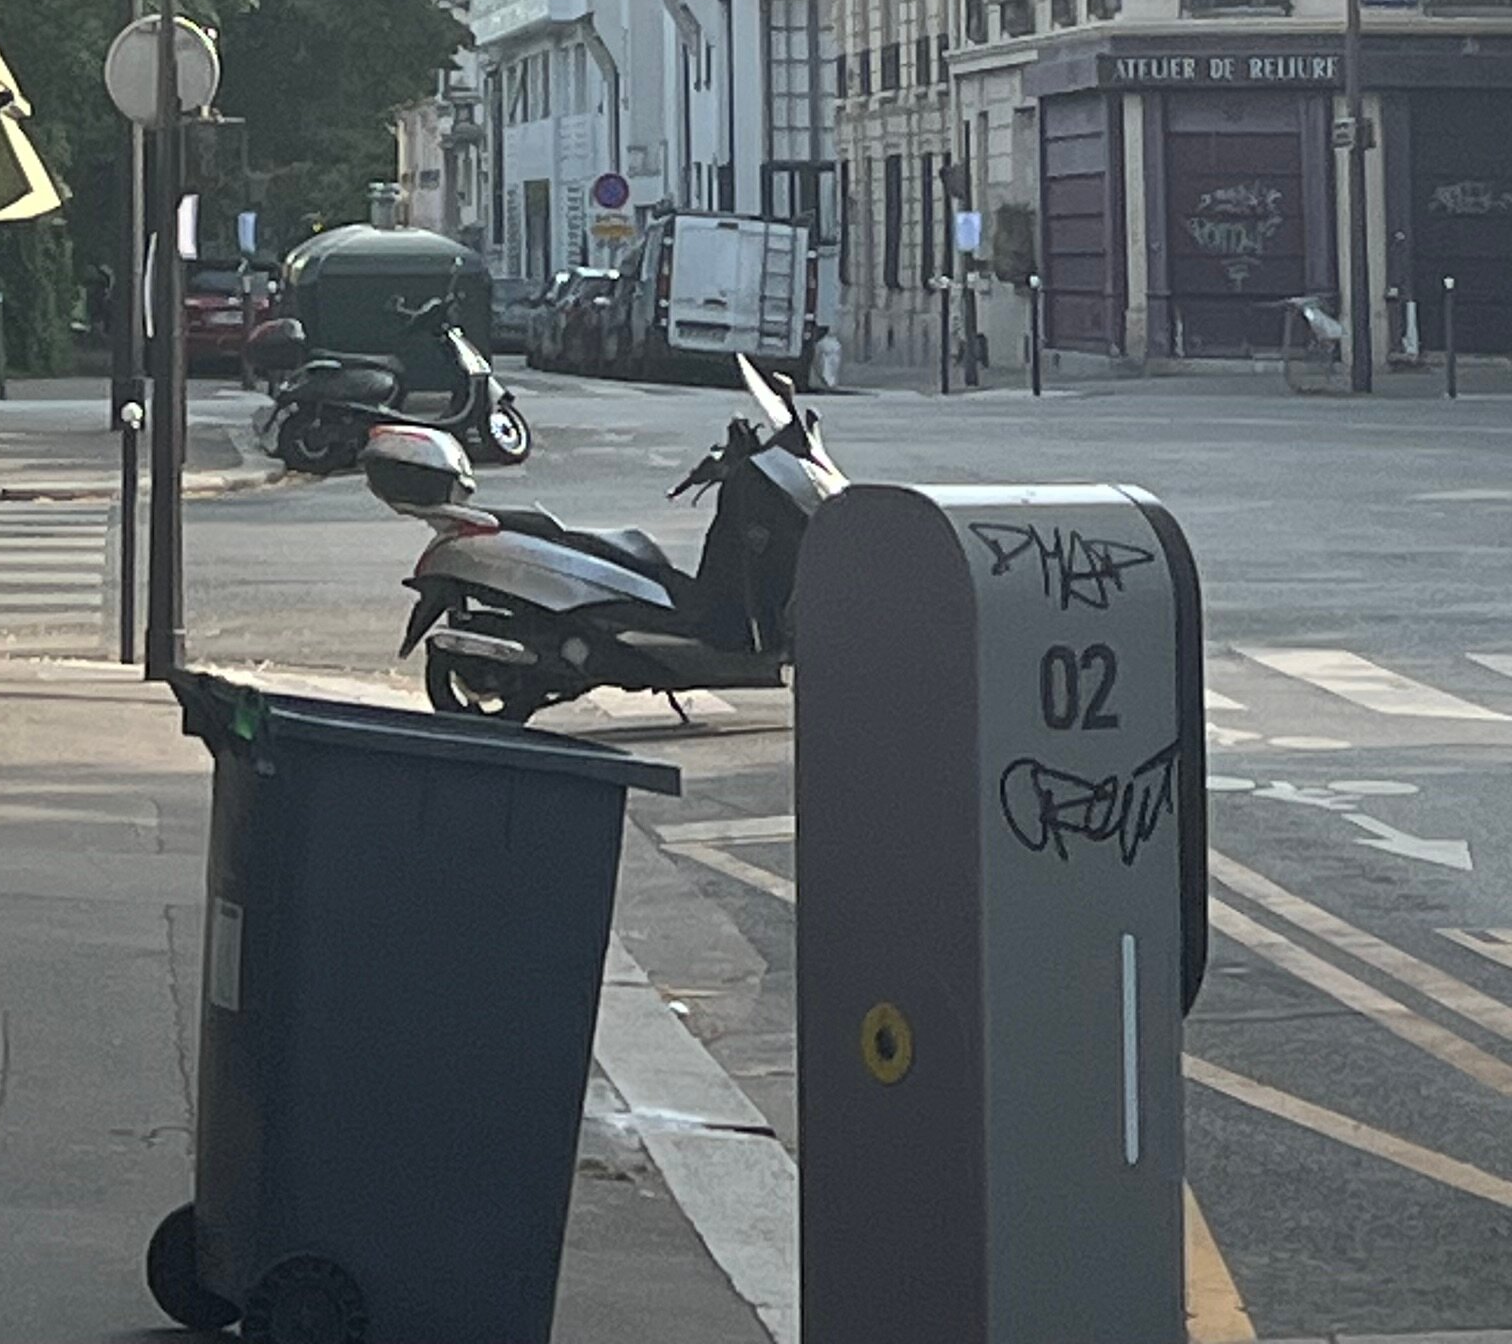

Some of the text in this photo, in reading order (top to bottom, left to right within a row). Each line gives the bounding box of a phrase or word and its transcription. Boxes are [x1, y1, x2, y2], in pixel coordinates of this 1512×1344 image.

[1113, 56, 1339, 81] ATELIER DE RELIURE
[1040, 643, 1119, 731] 02
